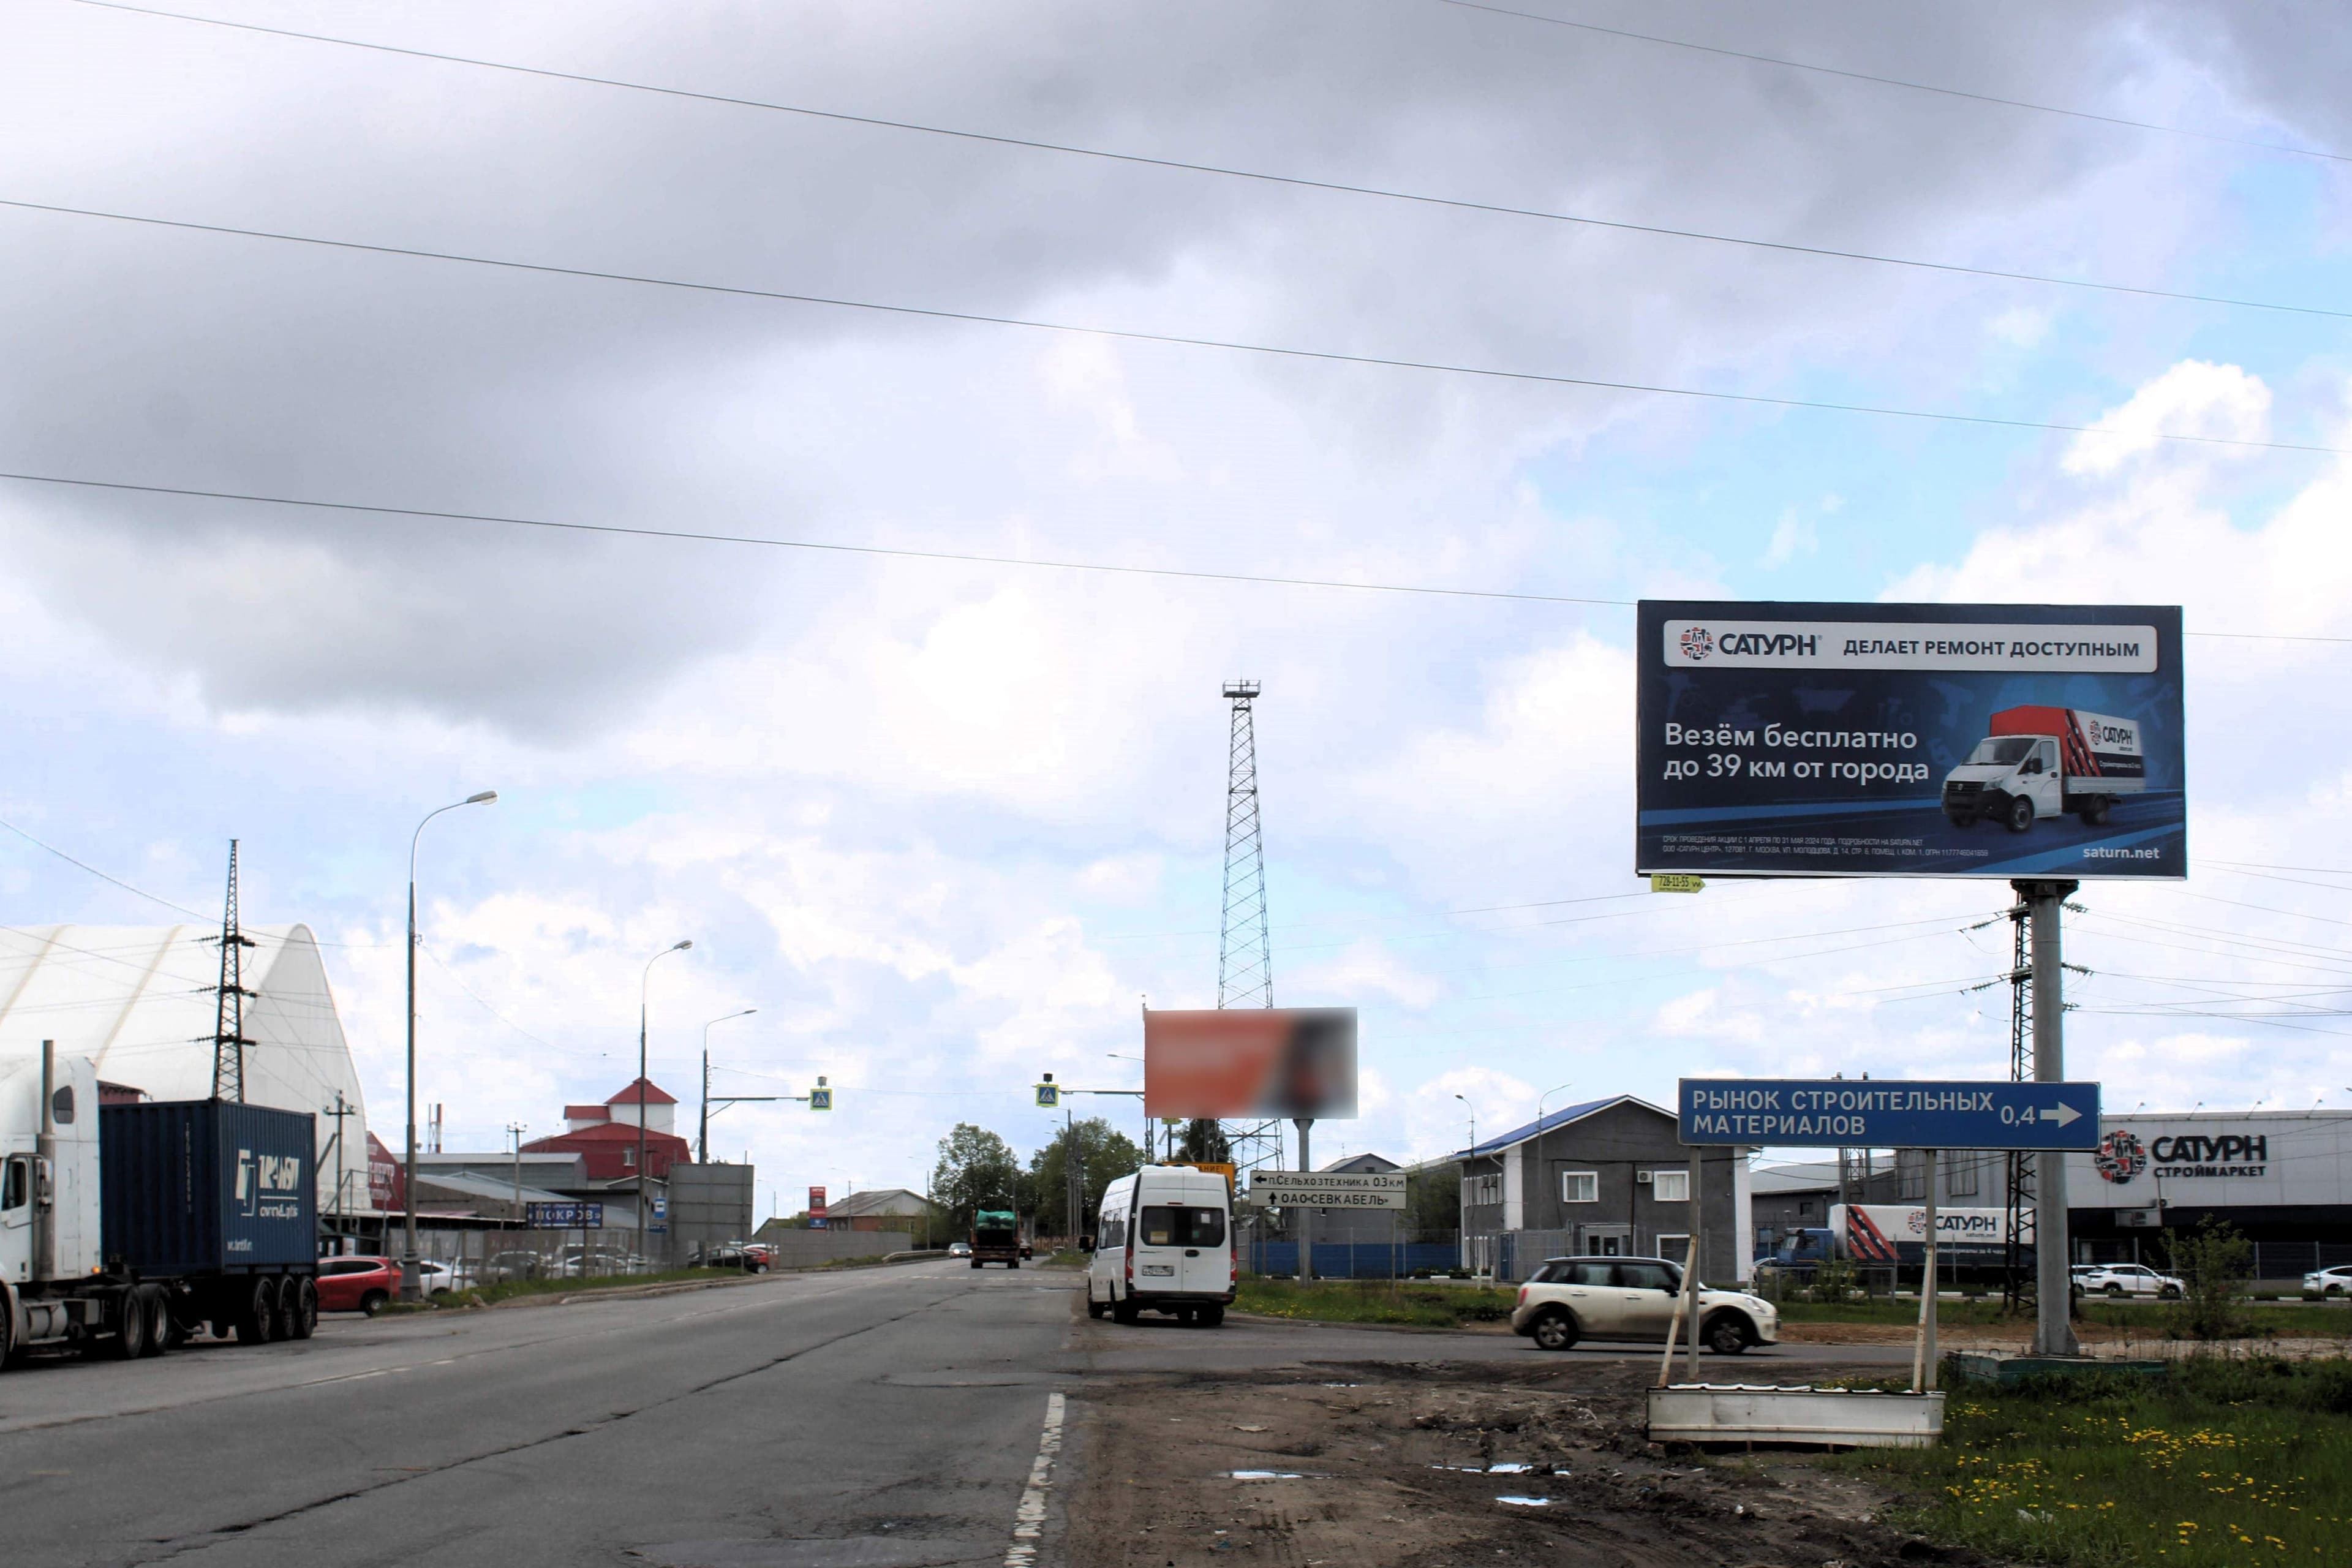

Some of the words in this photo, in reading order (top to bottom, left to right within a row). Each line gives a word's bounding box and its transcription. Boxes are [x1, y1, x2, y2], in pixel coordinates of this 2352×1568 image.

[1719, 633, 1816, 656] САТУРН
[1844, 639, 1919, 656] ДЕЛАЕТ
[1925, 641, 2005, 655] РЕМОНТ
[2010, 641, 2139, 658] ДОСТУПНЫМ
[1665, 723, 1754, 746] Везём
[1764, 723, 1917, 748] бесплатно
[1664, 760, 1700, 780] до
[1706, 753, 1741, 777] 39
[1750, 761, 1785, 777] км
[1793, 761, 1824, 778] от
[1831, 762, 1929, 786] города
[2083, 847, 2160, 859] saturn.net
[1693, 1090, 1780, 1110] РЫНОК
[1792, 1091, 1994, 1112] СТРОИТЕЛЬНЫХ
[1693, 1115, 1866, 1136] МАТЕРИАЛОВ
[2000, 1105, 2035, 1127] 0,4
[2152, 1135, 2267, 1163] САТУРН
[2154, 1165, 2267, 1177] СТРОЙМАРКЕТ
[1936, 1216, 1996, 1231] САТУРН
